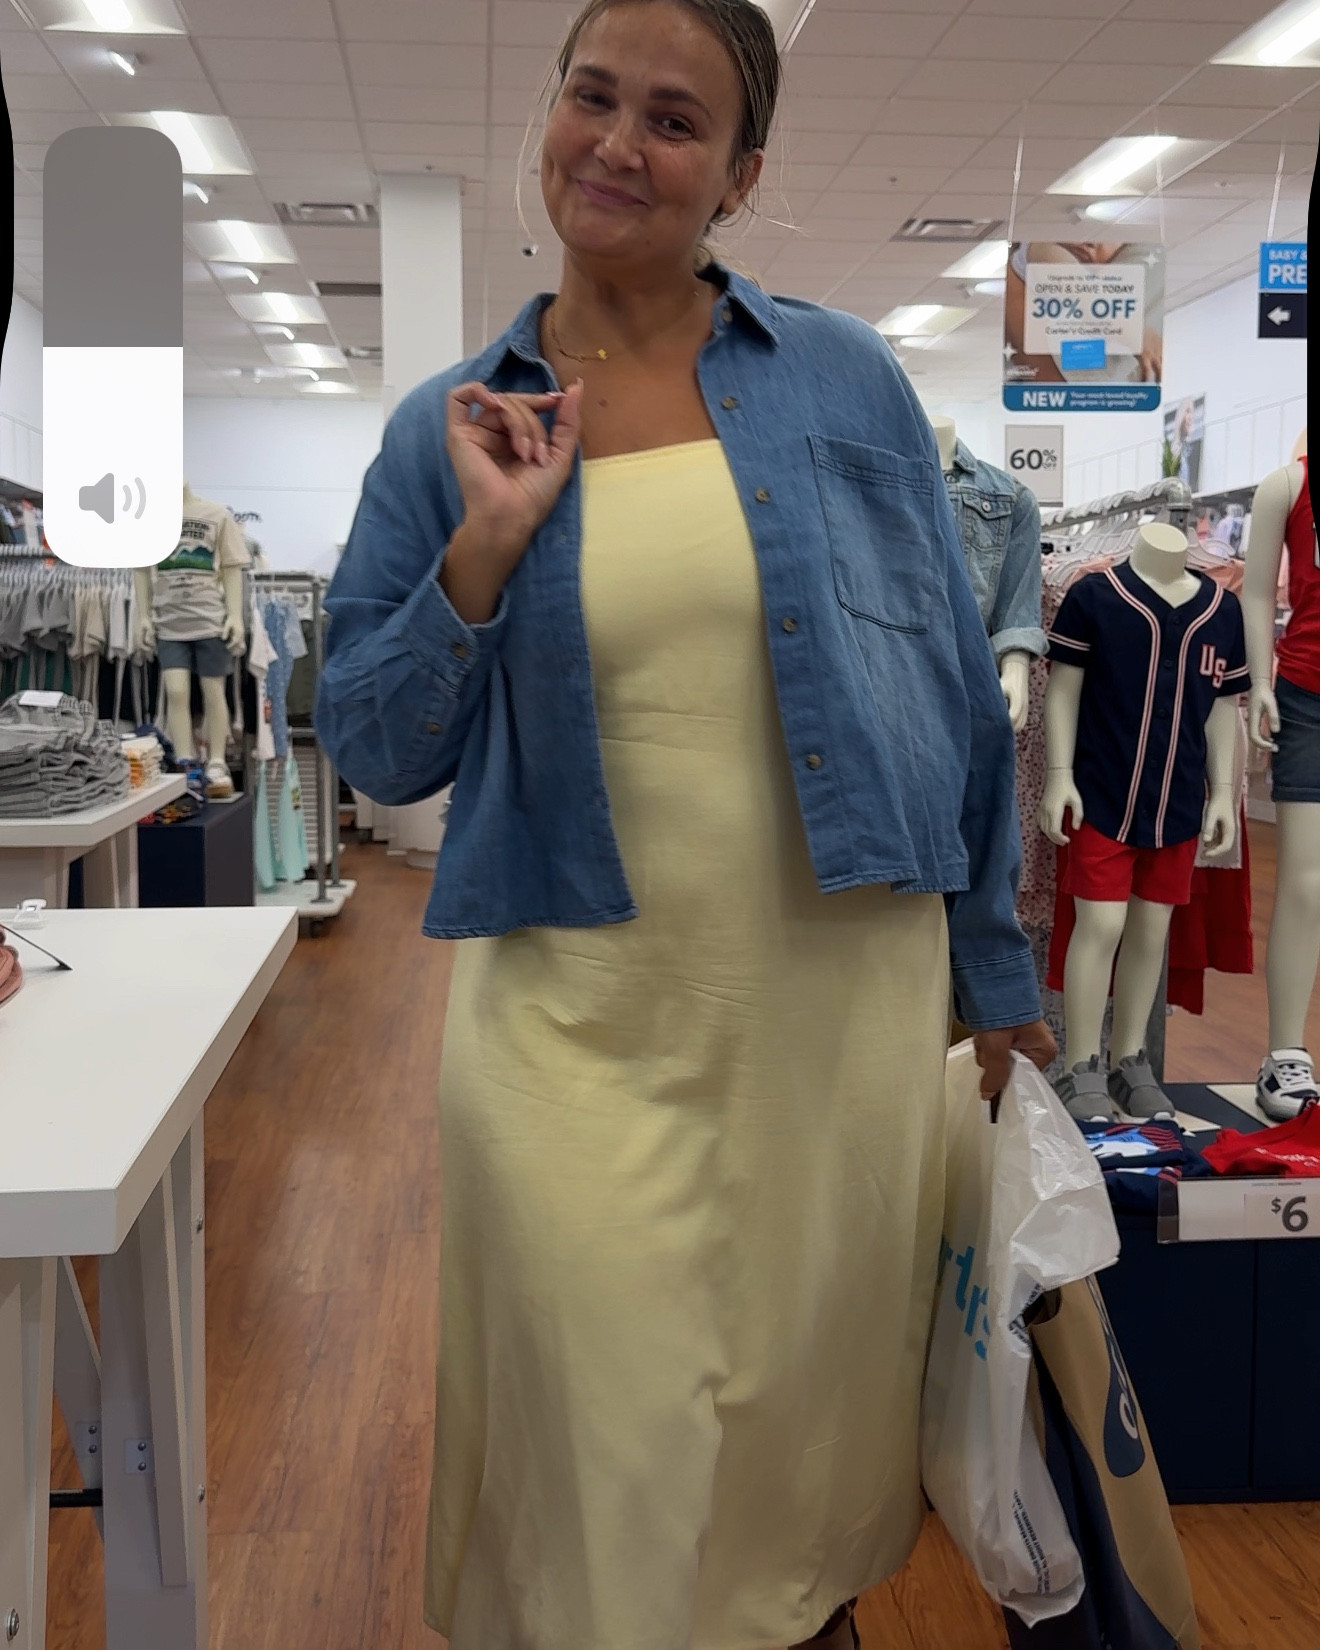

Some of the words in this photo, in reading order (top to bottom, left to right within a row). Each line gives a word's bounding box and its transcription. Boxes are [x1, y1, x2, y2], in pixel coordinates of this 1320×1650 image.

[1269, 250, 1298, 260] BABY
[1035, 284, 1062, 294] OPEN
[1065, 284, 1072, 294] &
[1075, 284, 1100, 294] SAVE
[1102, 284, 1134, 294] TODAY
[1032, 298, 1083, 319] 30%
[1091, 298, 1136, 319] OFF
[1078, 326, 1101, 335] Credit
[1103, 326, 1122, 335] Card
[1023, 391, 1066, 408] NEW
[1200, 643, 1227, 688] US
[1271, 1196, 1309, 1232] $6
